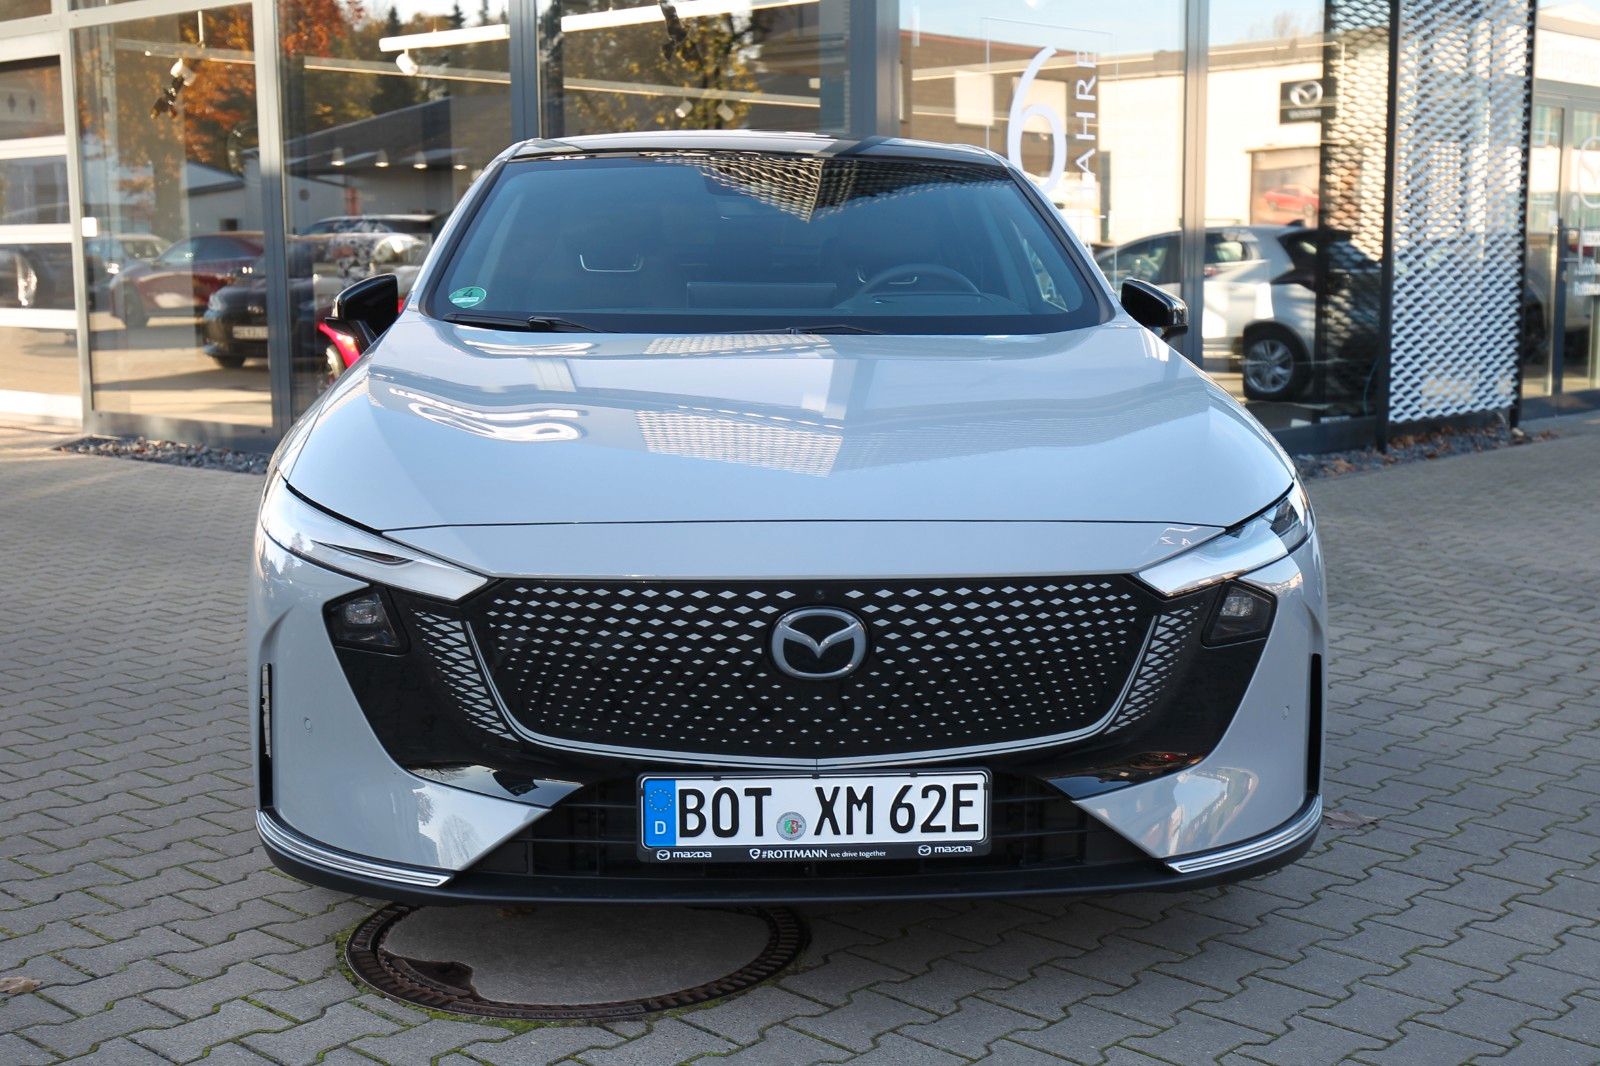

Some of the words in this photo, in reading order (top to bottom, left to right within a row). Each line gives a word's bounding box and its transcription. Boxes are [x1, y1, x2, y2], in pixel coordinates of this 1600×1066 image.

[1075, 51, 1096, 188] AHRE
[463, 288, 473, 297] 4
[678, 787, 772, 838] BOT
[814, 786, 874, 836] XM
[889, 783, 979, 834] 62E
[654, 820, 667, 835] D
[761, 849, 828, 859] #ROTTMANN
[859, 849, 887, 859] together
[934, 845, 973, 853] mazda
[672, 850, 712, 859] mazda
